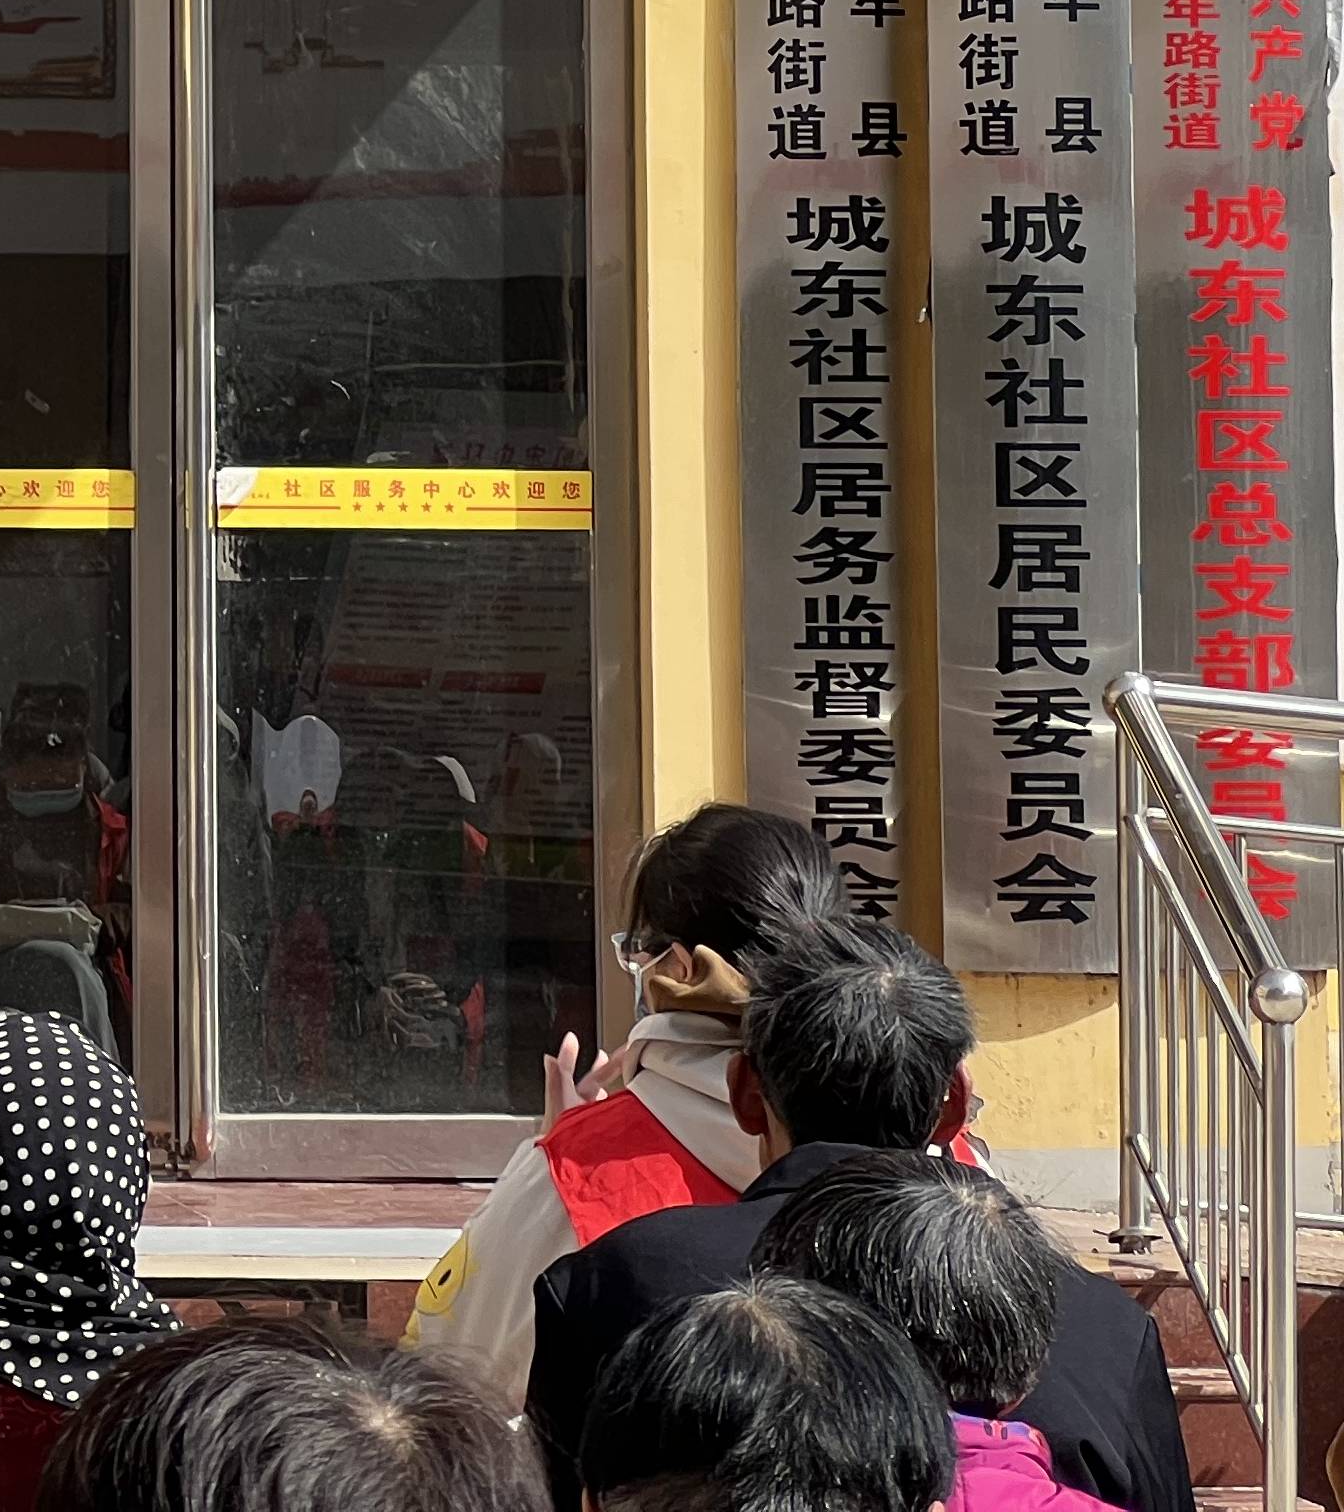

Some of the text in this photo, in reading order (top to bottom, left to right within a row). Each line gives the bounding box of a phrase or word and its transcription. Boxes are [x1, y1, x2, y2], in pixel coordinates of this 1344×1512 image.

[283, 479, 582, 500] 社区服务中心欢迎您
[981, 193, 1097, 924] 城东社区居民委员会
